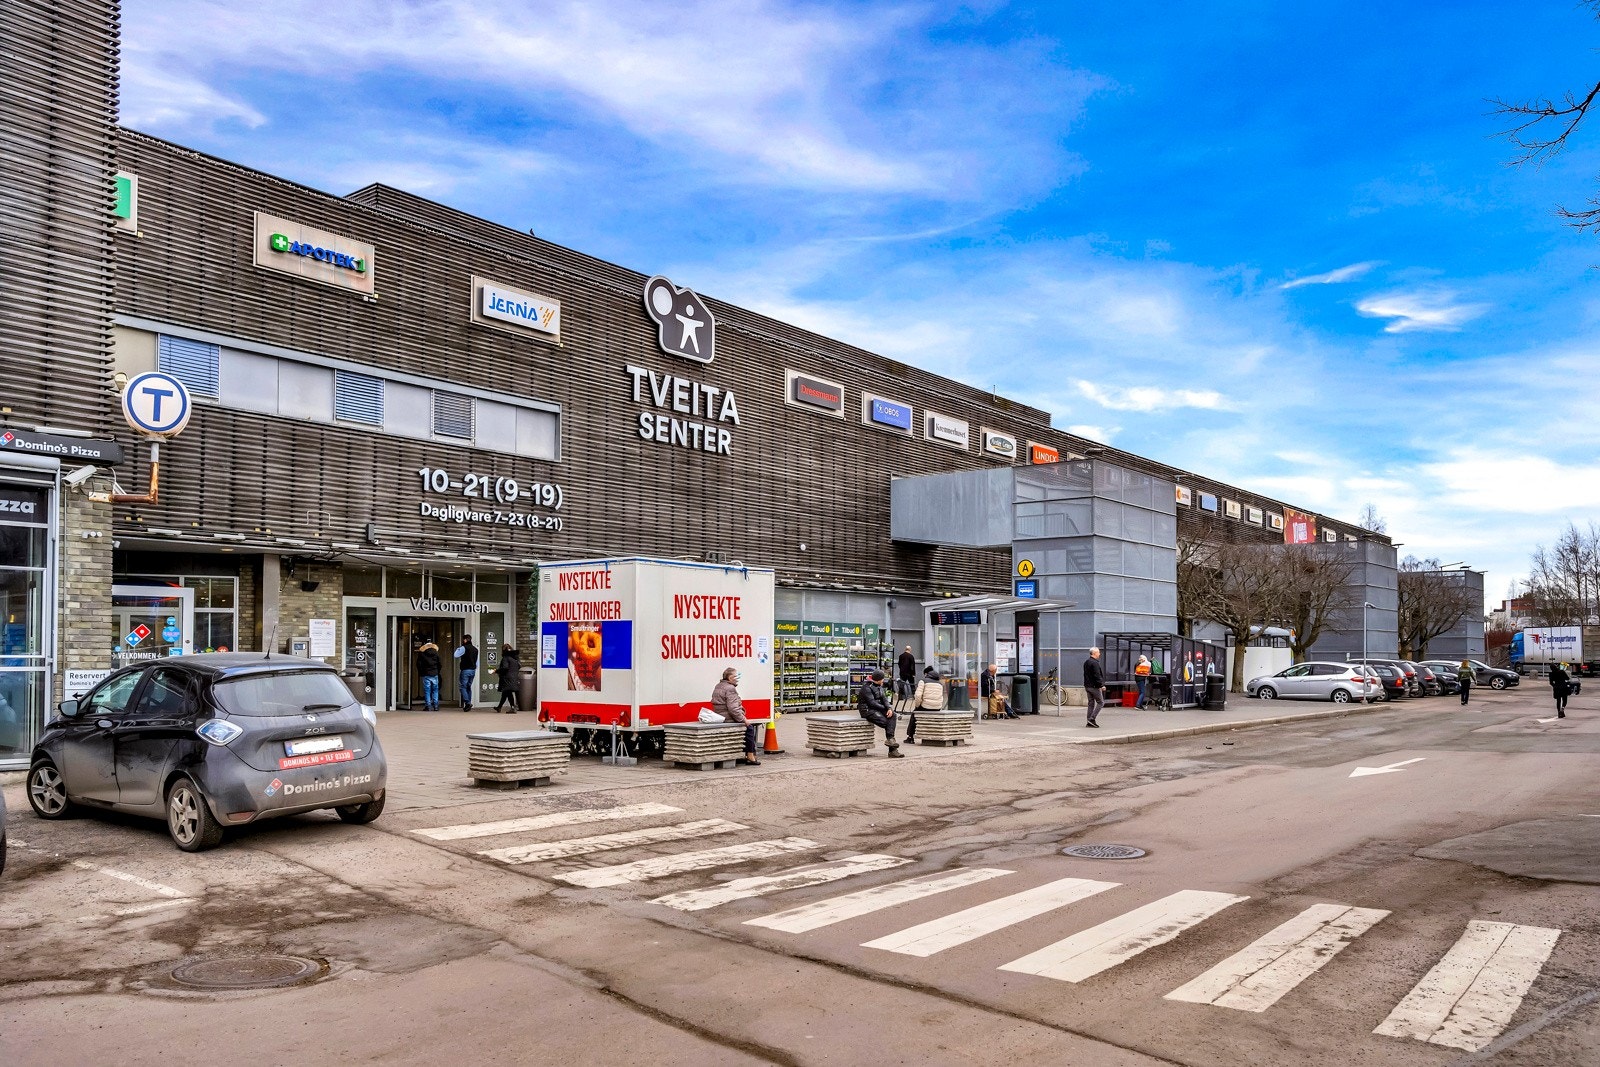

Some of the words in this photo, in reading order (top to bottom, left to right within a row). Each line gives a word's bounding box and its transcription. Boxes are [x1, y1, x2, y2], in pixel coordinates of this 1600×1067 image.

[625, 364, 740, 425] TVEITA
[801, 384, 839, 403] Dressmann
[142, 387, 173, 422] T
[639, 411, 732, 455] SENTER
[15, 438, 68, 454] Domino's
[71, 445, 101, 458] Pizza
[1035, 450, 1058, 463] LINDEX
[418, 467, 490, 499] 10-21
[495, 476, 563, 511] (9-19)
[420, 502, 492, 523] Dagligvare
[493, 511, 524, 527] 7-23
[526, 513, 563, 532] (8-21)
[1022, 563, 1029, 573] A
[559, 569, 612, 591] NYSTEKTE
[410, 596, 489, 614] Velkommen
[549, 600, 621, 621] SMULTRINGER
[674, 594, 741, 620] NYSTEKTE
[117, 652, 157, 660] VELKOMMEN
[661, 634, 752, 660] SMULTRINGER
[284, 777, 341, 795] Domino's
[343, 774, 371, 786] Pizza
